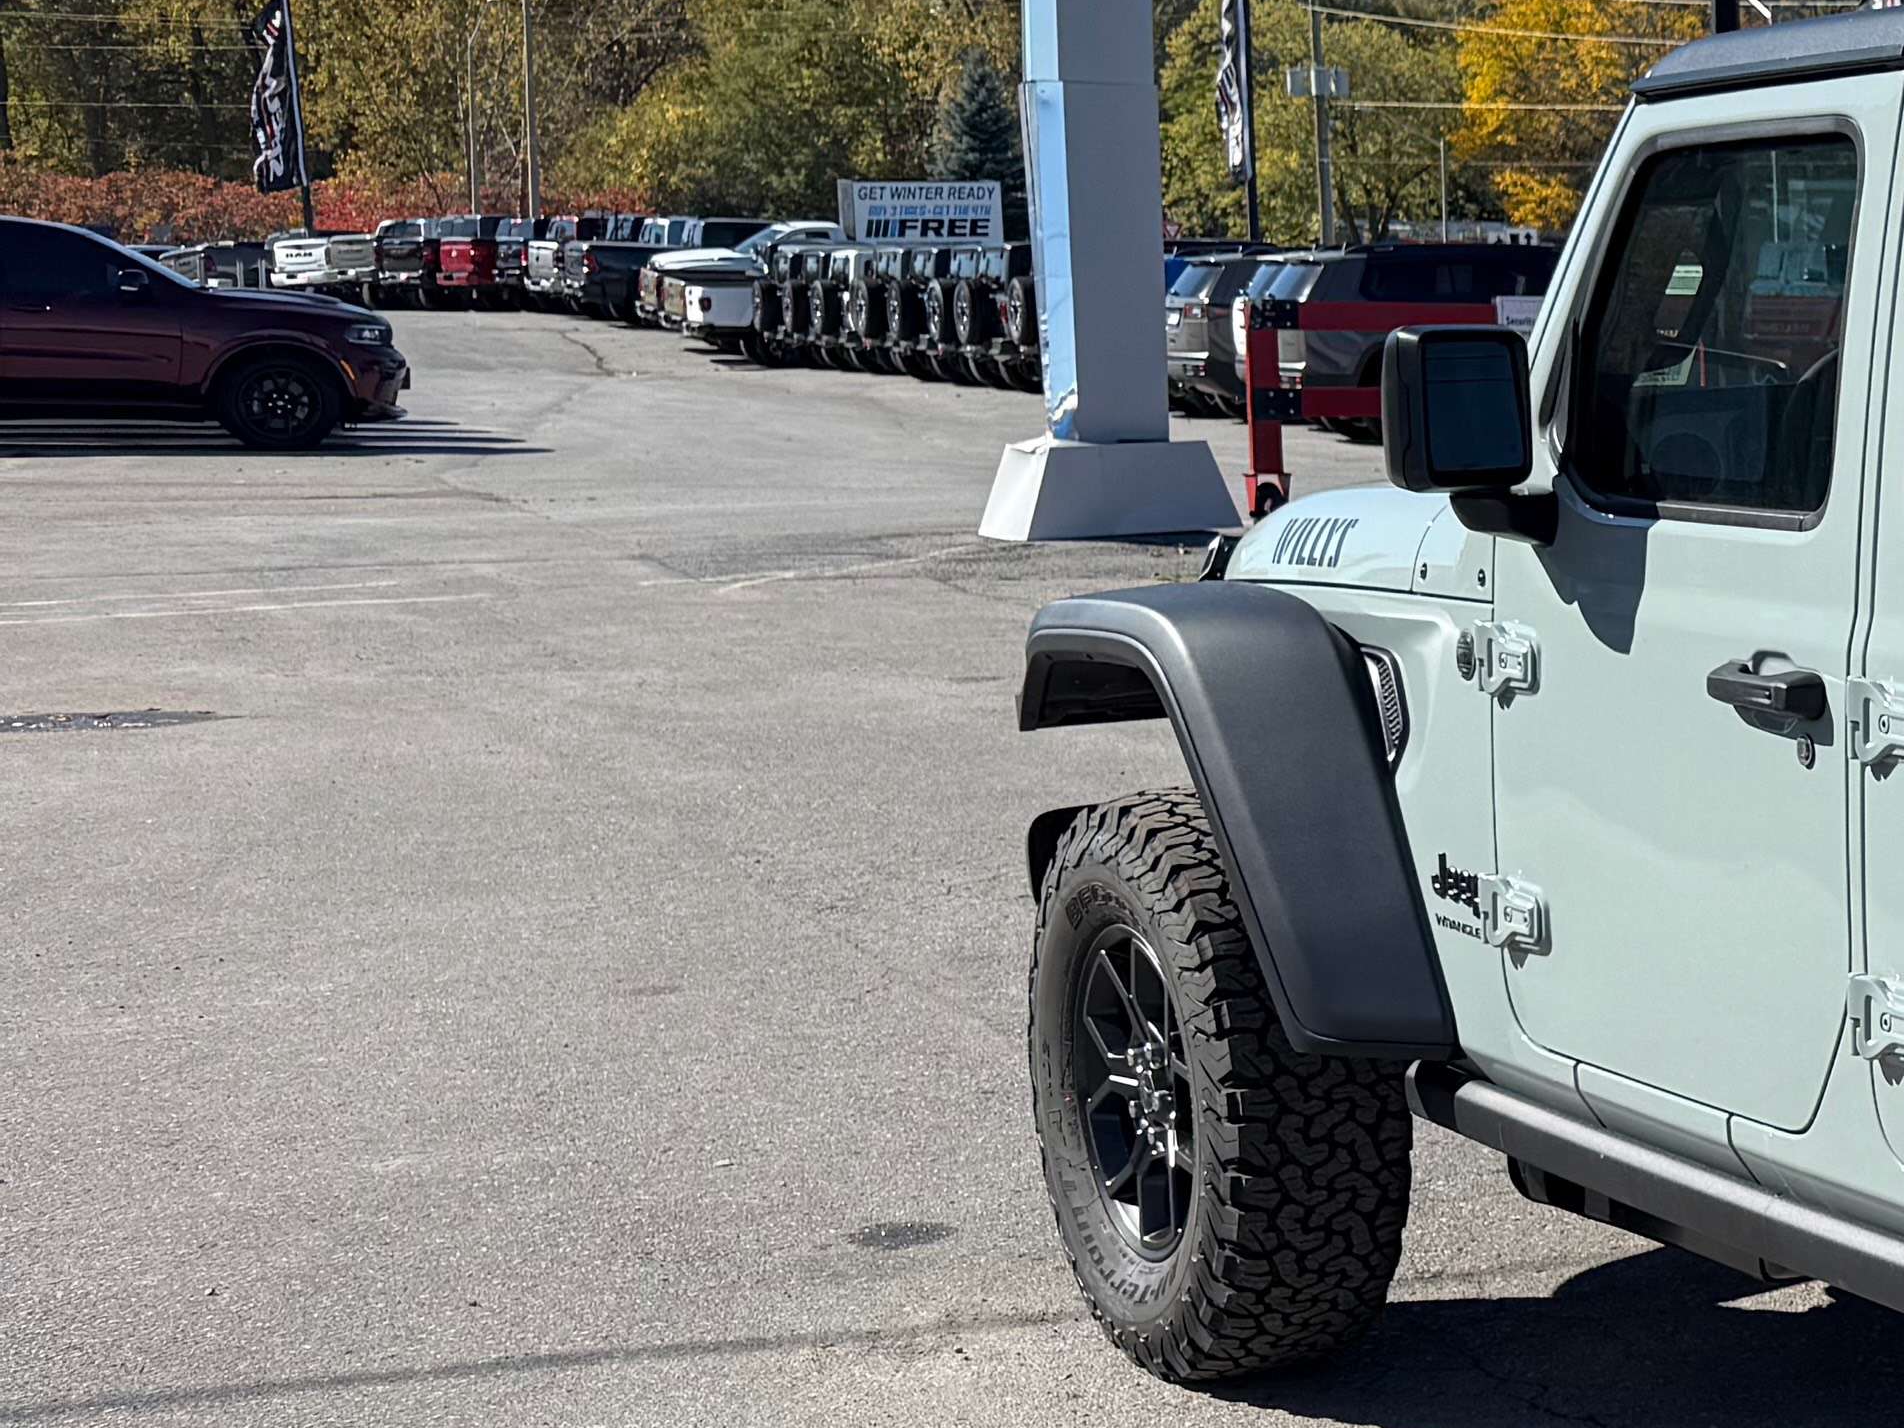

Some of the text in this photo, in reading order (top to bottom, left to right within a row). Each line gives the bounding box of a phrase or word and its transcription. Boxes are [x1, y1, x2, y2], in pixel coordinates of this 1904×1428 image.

[858, 186, 995, 200] GET WINTER READY
[898, 219, 990, 237] FREE
[1272, 518, 1359, 568] WILLYS
[1436, 913, 1481, 940] WRANGLE
